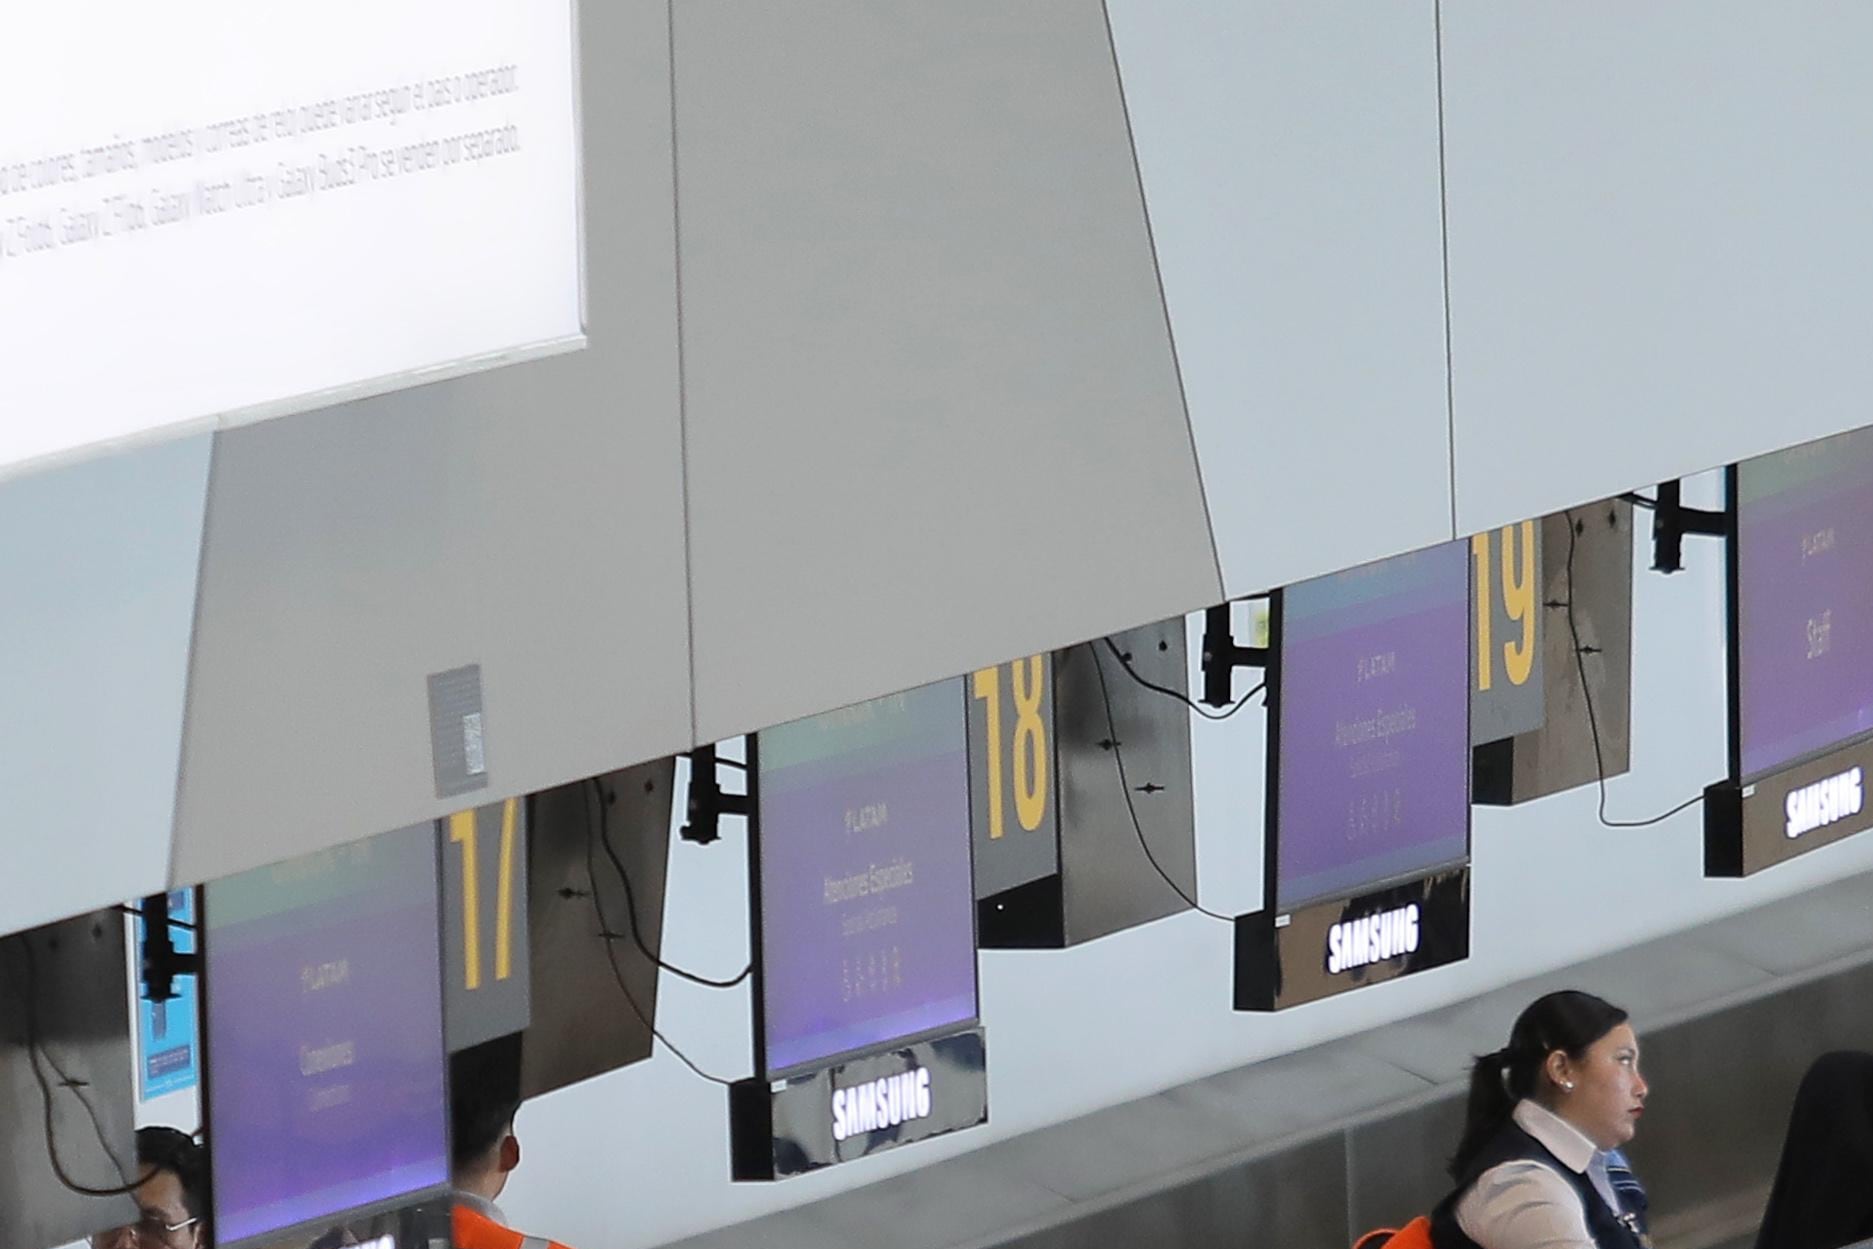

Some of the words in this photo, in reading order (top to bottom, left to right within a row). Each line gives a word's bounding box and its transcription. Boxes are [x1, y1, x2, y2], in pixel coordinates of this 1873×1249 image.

[1472, 520, 1535, 690] 19
[974, 656, 1048, 839] 18
[1786, 767, 1862, 838] SAMSUNG
[450, 797, 517, 989] 17
[1329, 903, 1419, 974] SAMSUNG
[833, 1067, 931, 1141] SAMSUNG
